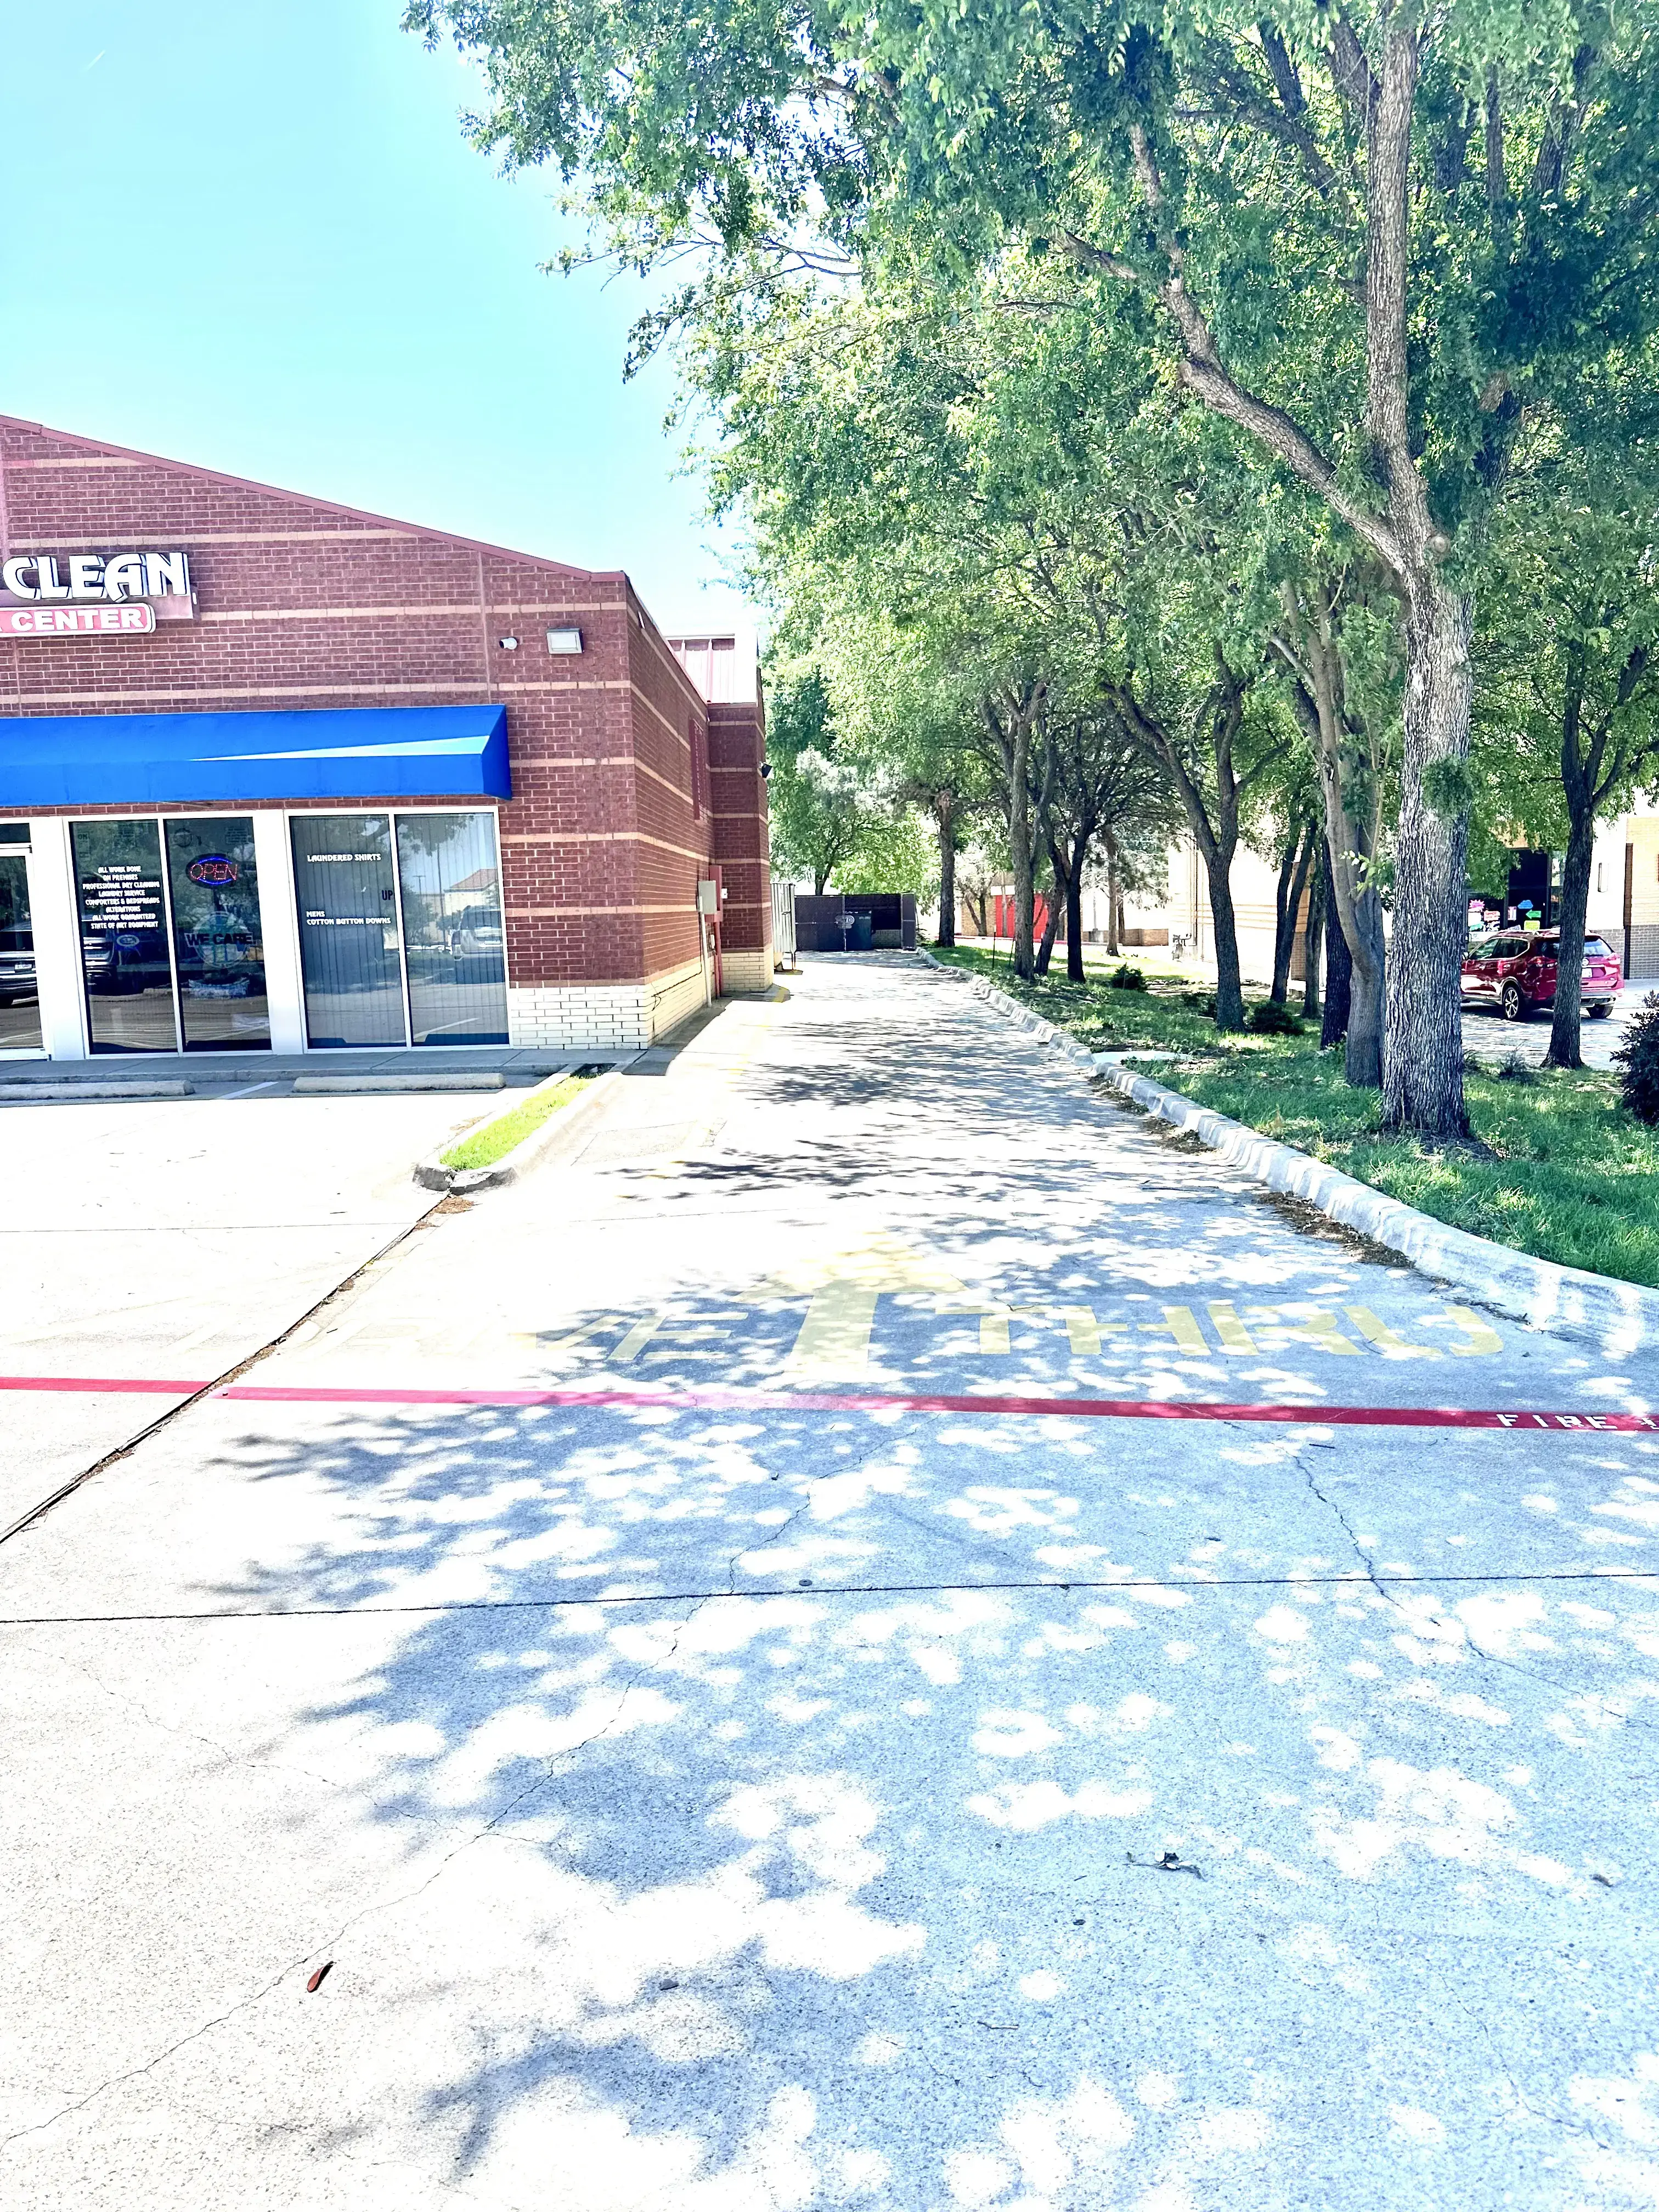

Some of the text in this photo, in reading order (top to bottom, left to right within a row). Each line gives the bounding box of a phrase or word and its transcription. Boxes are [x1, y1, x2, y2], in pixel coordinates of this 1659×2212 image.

[2, 552, 190, 602] CLEAN
[10, 608, 144, 632] CENTER
[190, 864, 238, 881] OPEN
[184, 933, 253, 947] WE CARE
[935, 1304, 1504, 1358] THRU
[1496, 1414, 1618, 1430] FIRE
